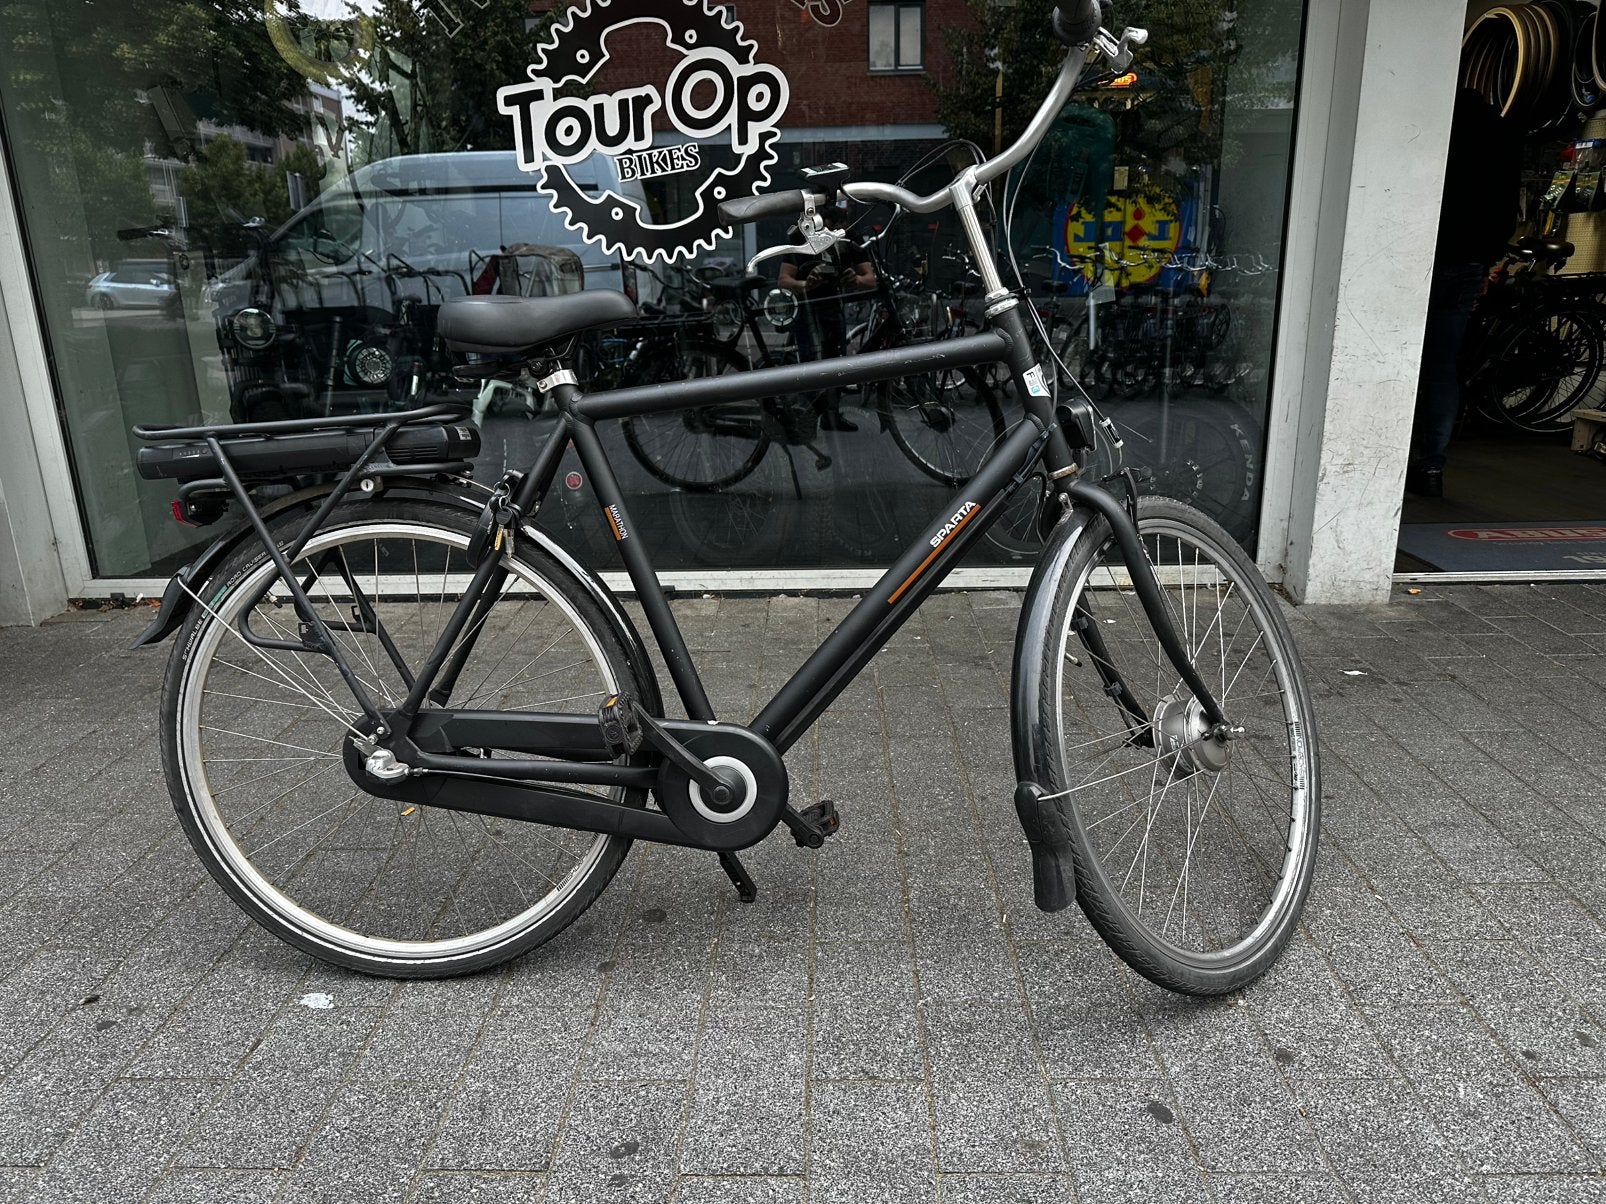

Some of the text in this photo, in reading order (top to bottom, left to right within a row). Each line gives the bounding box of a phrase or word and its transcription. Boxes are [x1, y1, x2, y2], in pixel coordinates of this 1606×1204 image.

[499, 49, 787, 169] Tour Op
[615, 143, 700, 182] BIKES
[1230, 423, 1254, 500] KENDA
[609, 503, 629, 540] MARATHON
[930, 501, 976, 548] SPARTA
[1476, 528, 1606, 539] ABUS
[182, 618, 203, 661] SCHWALBE
